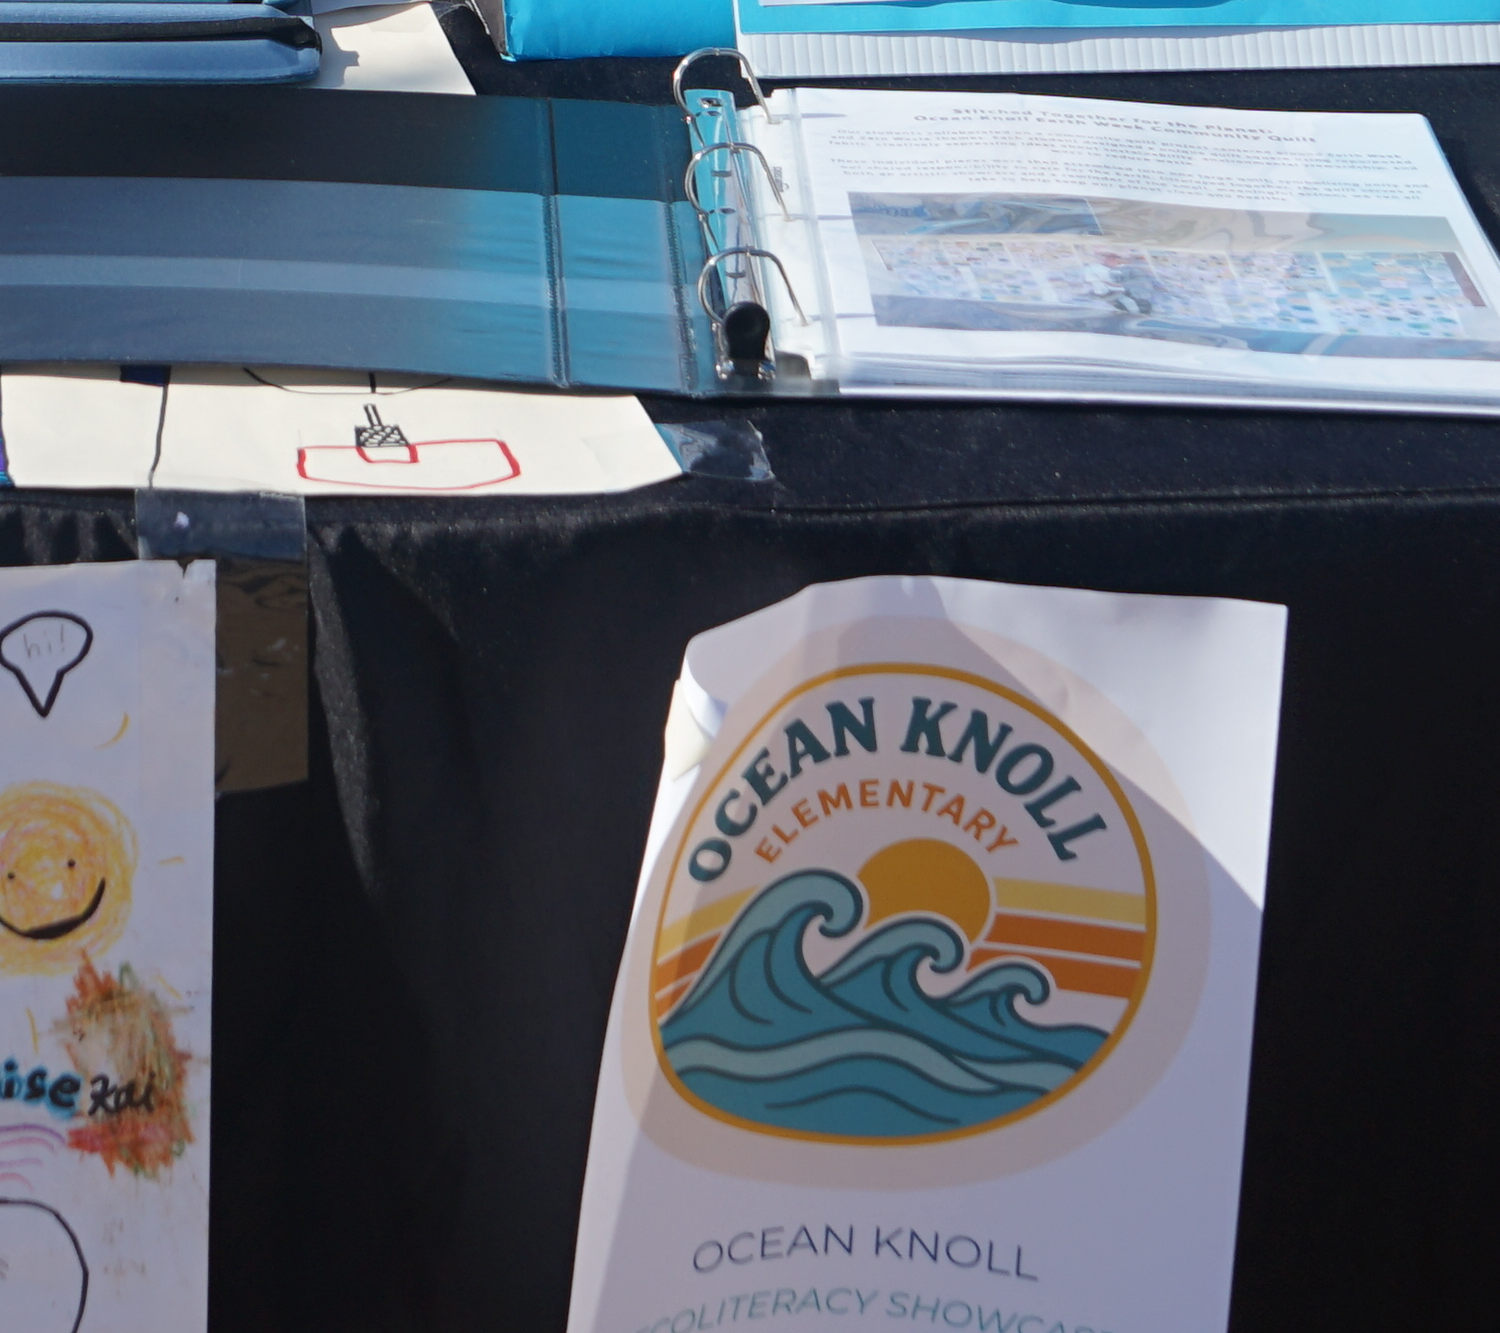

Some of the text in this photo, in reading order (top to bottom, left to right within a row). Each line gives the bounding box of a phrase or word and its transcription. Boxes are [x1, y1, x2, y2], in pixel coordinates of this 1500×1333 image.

[22, 621, 67, 662] hi!
[686, 696, 1107, 884] OCEAN KNOLL
[753, 779, 1019, 865] ELEMENTARY
[691, 1225, 1040, 1282] OCEAN KNOLL
